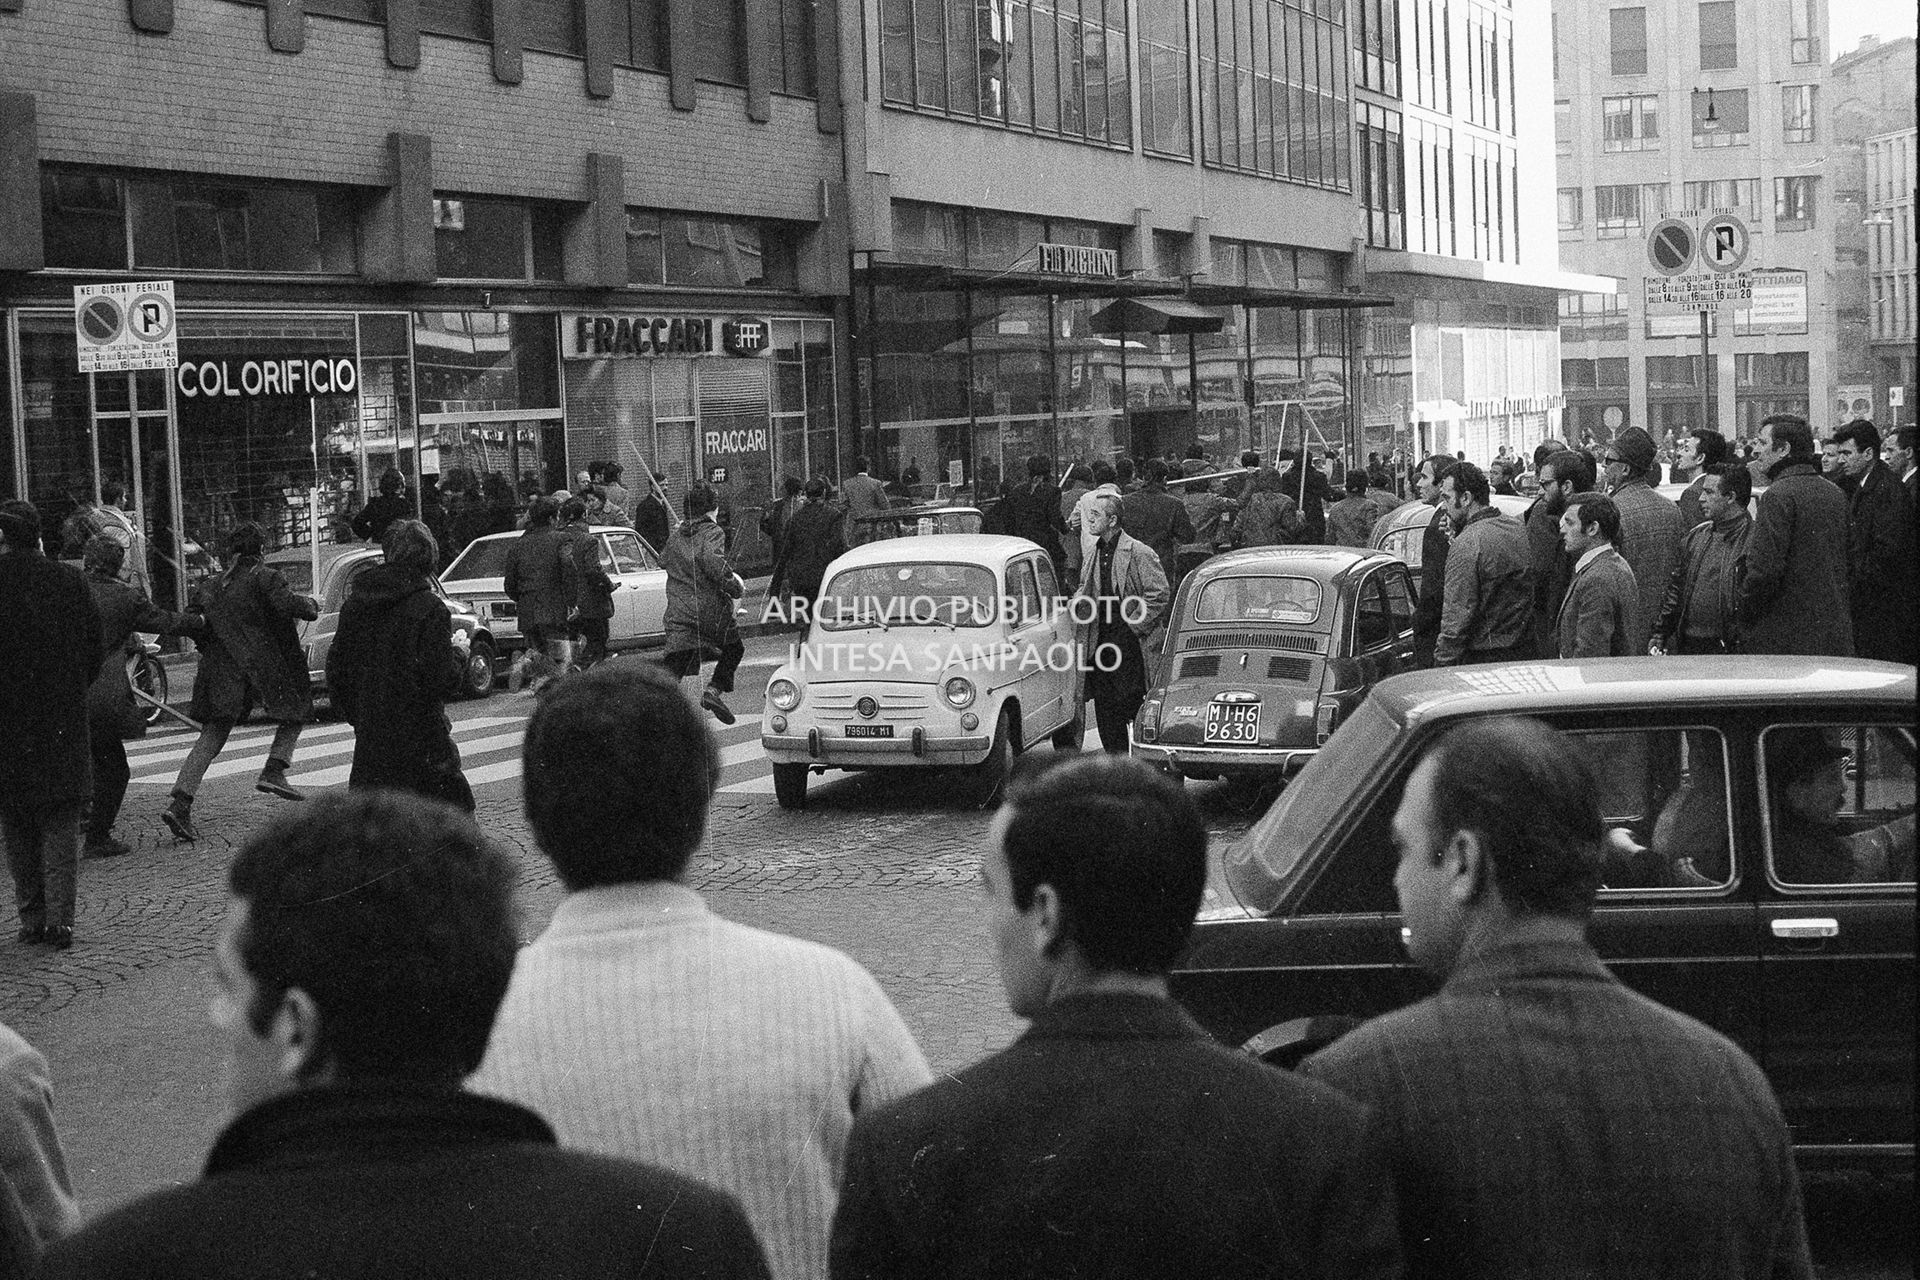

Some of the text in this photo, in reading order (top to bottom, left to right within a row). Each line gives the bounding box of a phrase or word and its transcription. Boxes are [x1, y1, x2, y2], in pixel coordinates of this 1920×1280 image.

[1064, 247, 1118, 276] RIGHINI
[80, 282, 168, 296] NEI GIORNI FERIALI
[1691, 292, 1699, 301] 16
[1716, 290, 1724, 300] 16
[1740, 289, 1752, 299] 20
[576, 316, 714, 353] FRACCARI
[167, 358, 176, 366] 20
[178, 358, 356, 397] COLORIFICIO
[705, 429, 766, 454] FRACCARI
[846, 726, 876, 736] 796014
[1207, 722, 1256, 740] 9630
